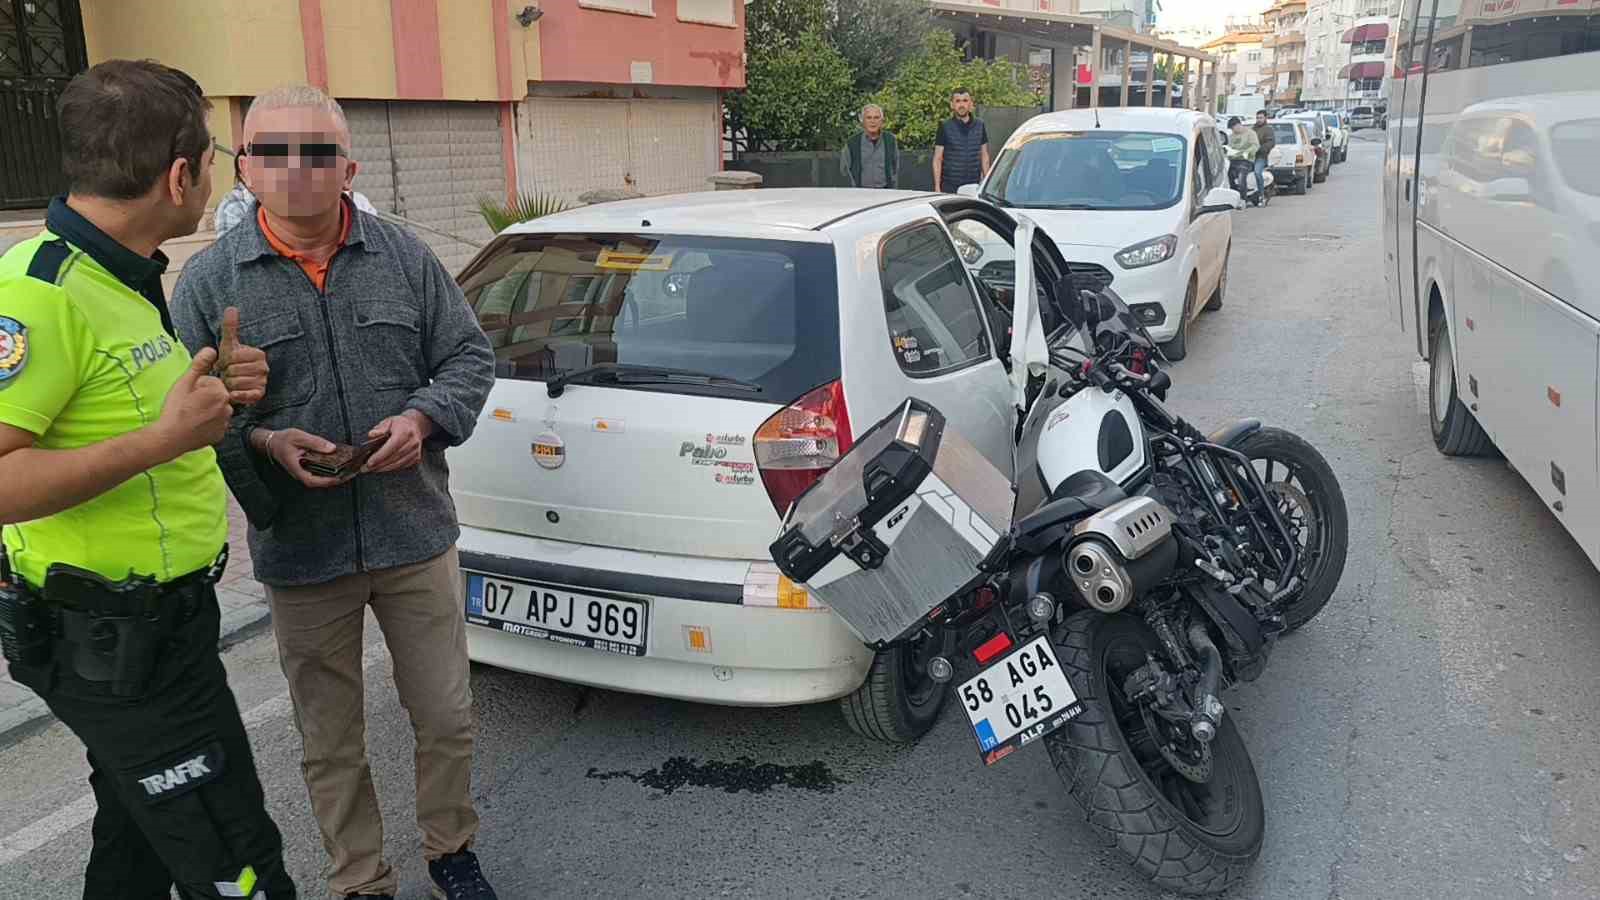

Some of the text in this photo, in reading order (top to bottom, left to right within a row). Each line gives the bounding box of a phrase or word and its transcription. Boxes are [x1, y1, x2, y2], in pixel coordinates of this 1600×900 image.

[472, 582, 638, 639] TR 07 APJ 969
[963, 644, 1053, 711] 58 AGA
[1005, 685, 1053, 728] 045
[983, 737, 998, 752] TR
[1020, 723, 1045, 743] ALP
